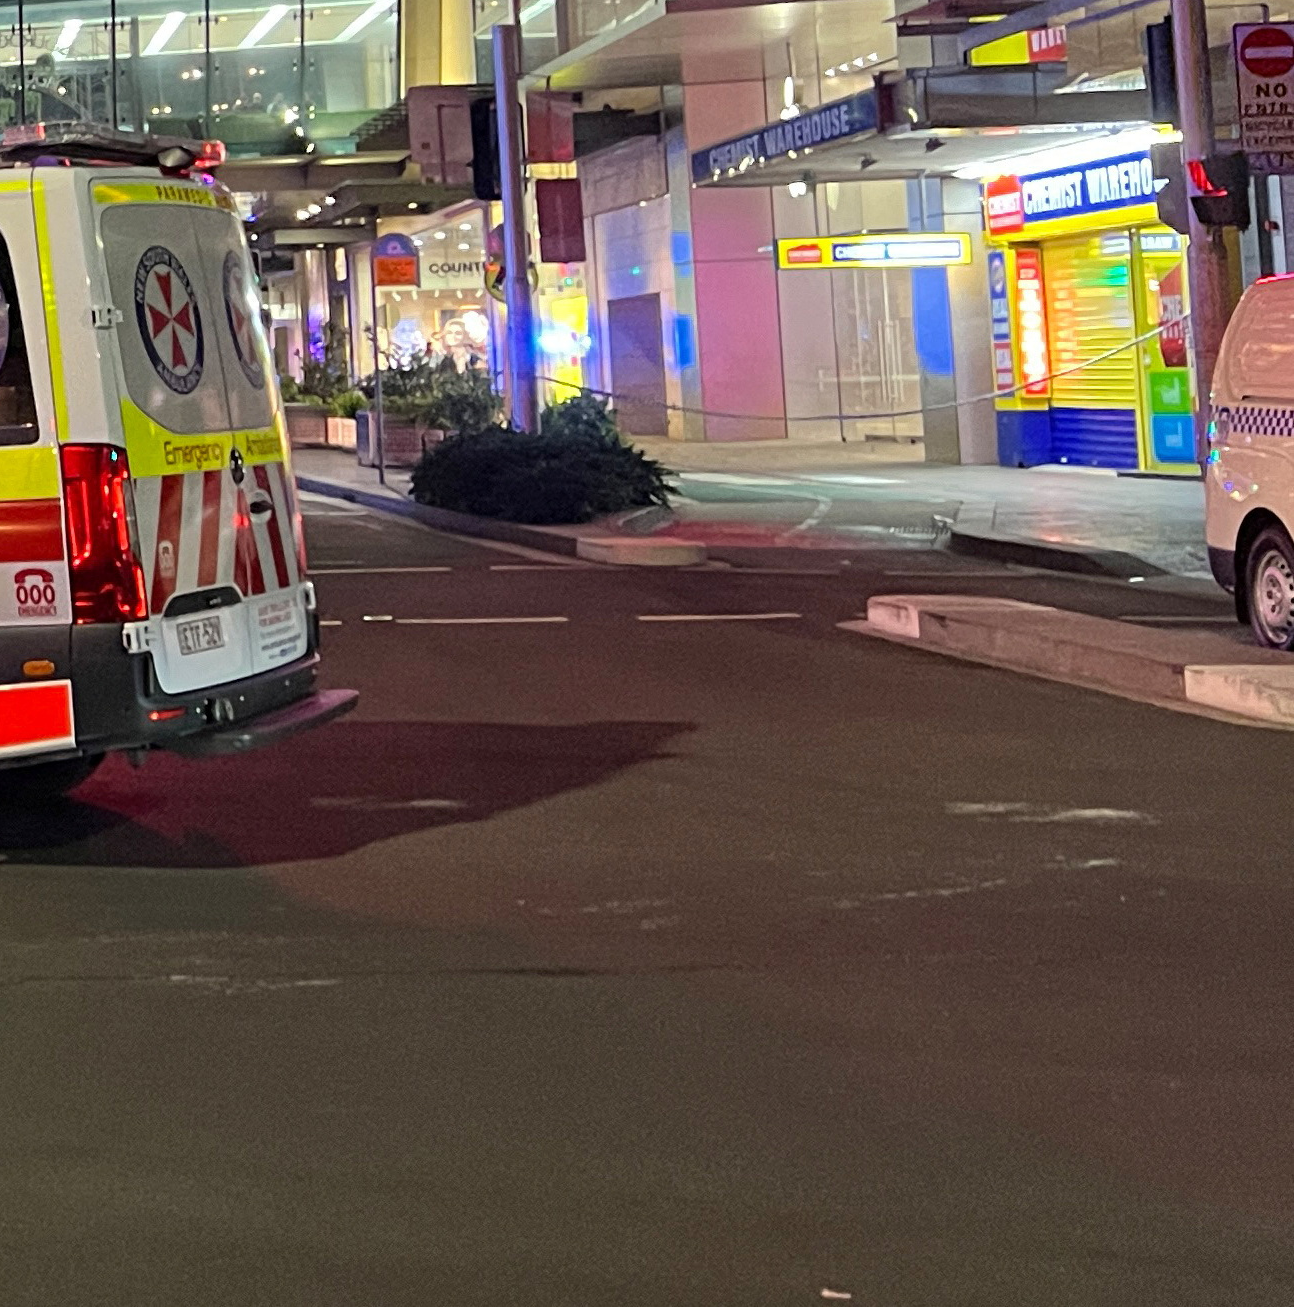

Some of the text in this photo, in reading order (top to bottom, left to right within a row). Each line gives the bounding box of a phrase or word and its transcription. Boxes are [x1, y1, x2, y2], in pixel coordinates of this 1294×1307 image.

[1255, 82, 1287, 98] NO
[764, 104, 850, 156] WAREHOUSE
[1022, 158, 1153, 215] CHEMIST WAREHO
[428, 261, 485, 274] COUNT
[164, 440, 225, 470] Emergency
[16, 584, 56, 605] 000
